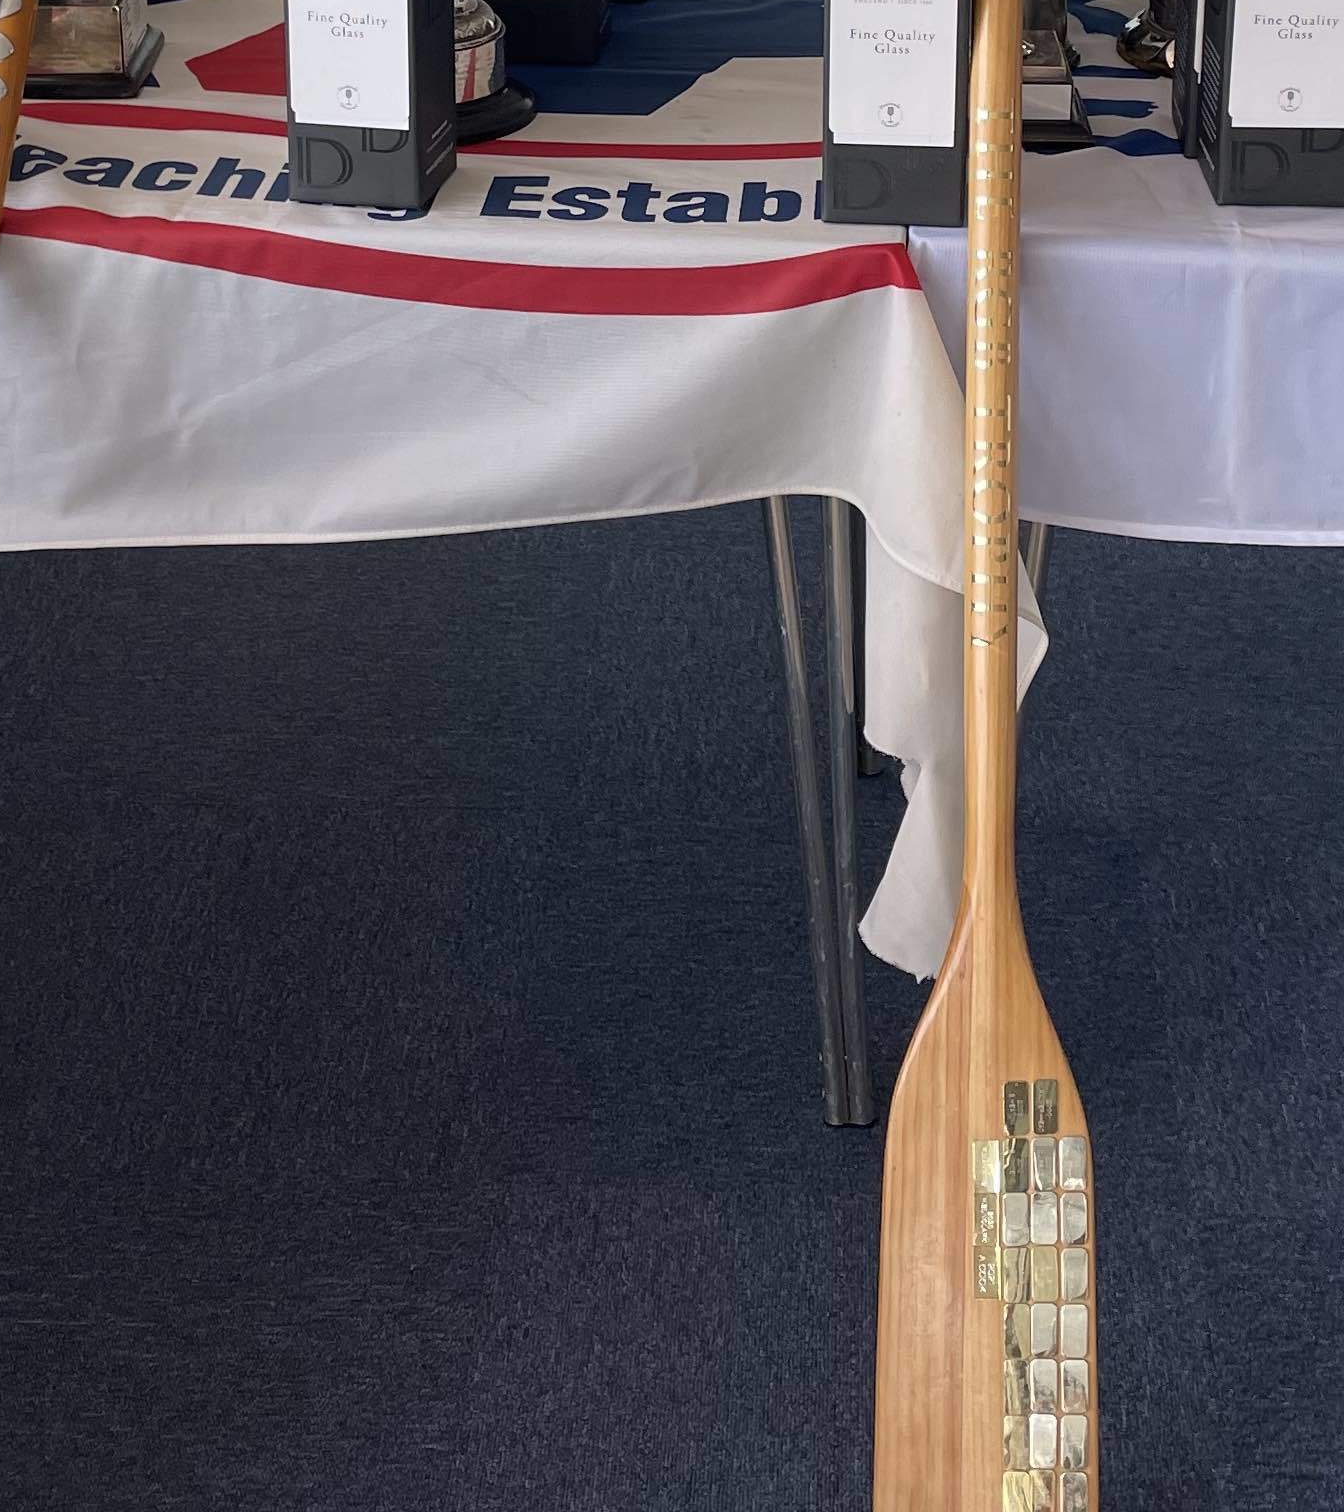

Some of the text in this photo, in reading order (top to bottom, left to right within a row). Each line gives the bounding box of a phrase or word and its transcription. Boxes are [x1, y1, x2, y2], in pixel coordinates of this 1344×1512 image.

[307, 10, 388, 29] Fine Quality
[1253, 14, 1340, 30] Fine Quality
[330, 26, 365, 39] Glass
[849, 28, 936, 44] Fine Quality
[1276, 28, 1313, 41] Glass
[874, 42, 911, 55] Glass
[479, 174, 822, 224] Estab
